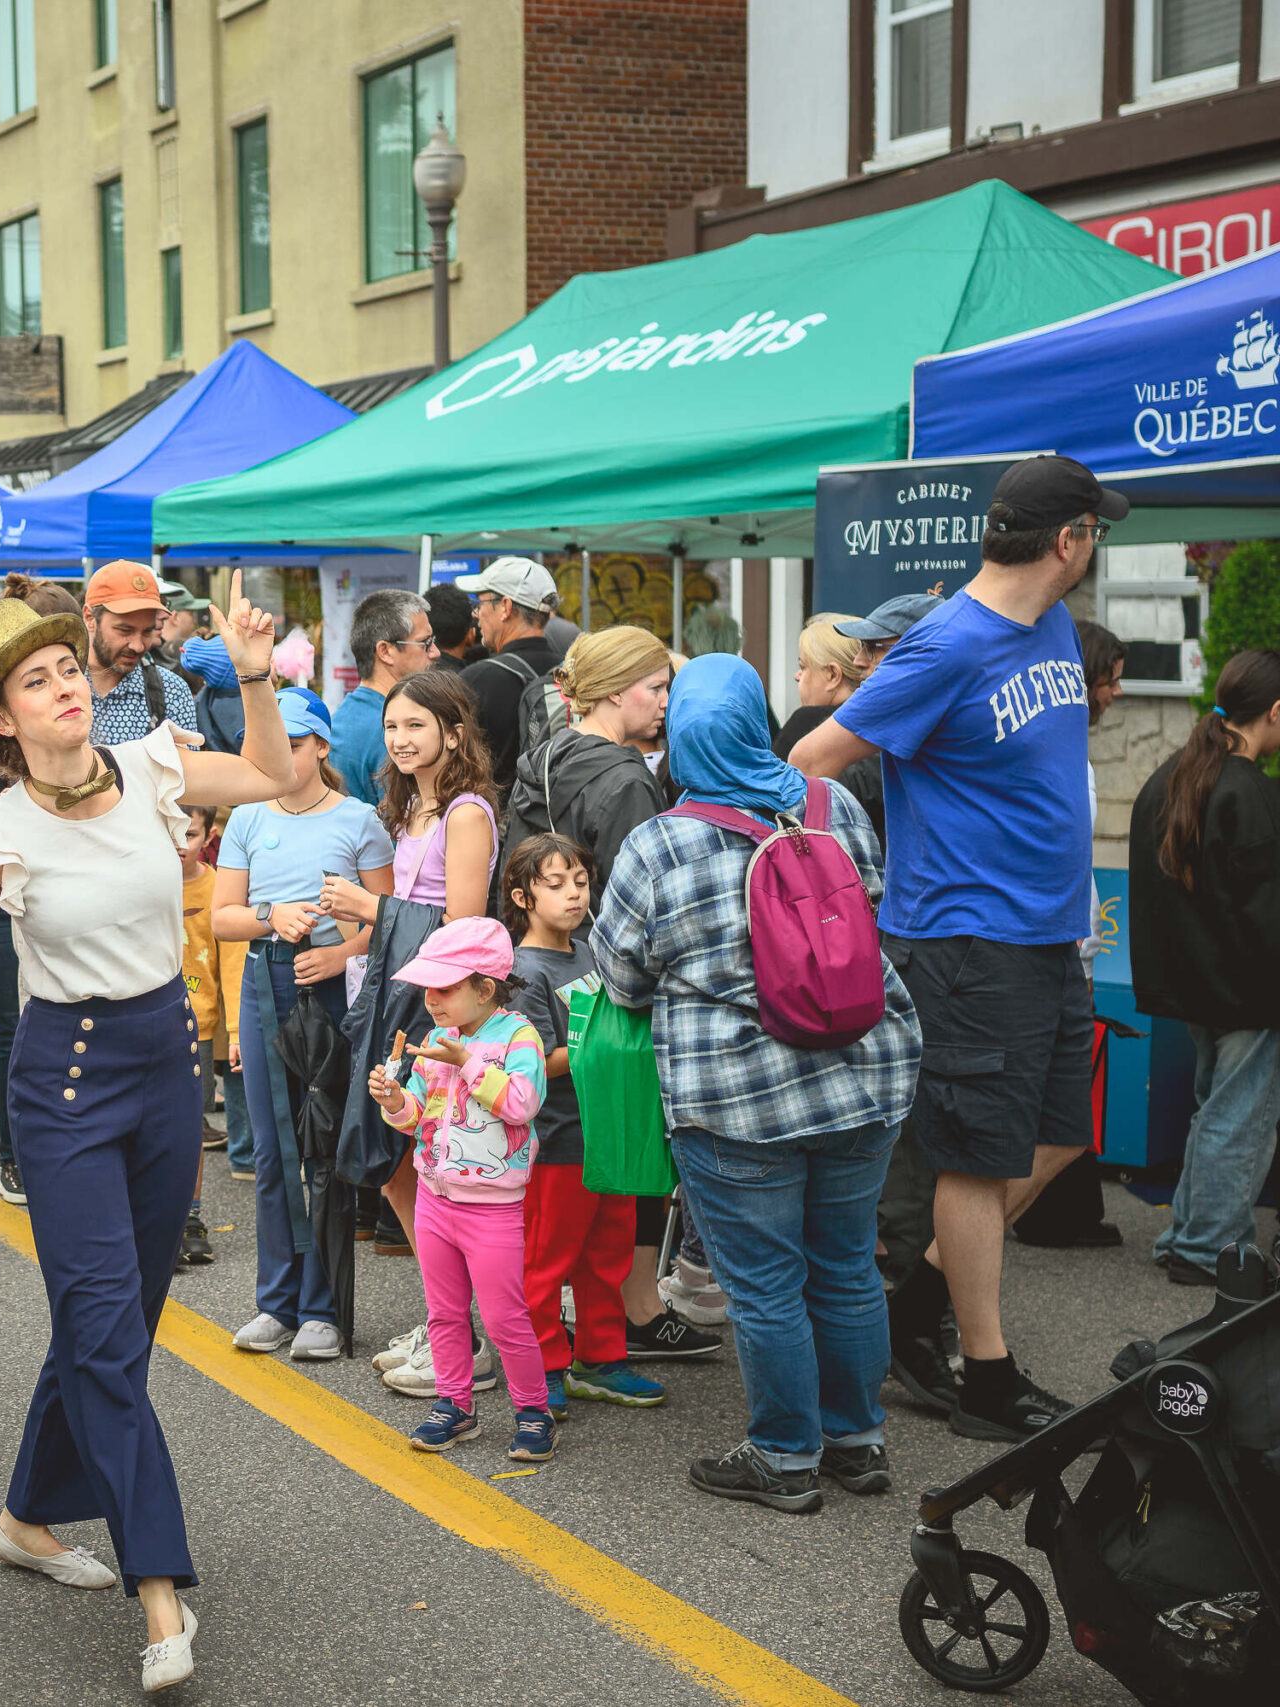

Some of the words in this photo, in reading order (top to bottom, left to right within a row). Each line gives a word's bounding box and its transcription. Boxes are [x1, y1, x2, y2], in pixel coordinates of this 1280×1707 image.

[1134, 381, 1181, 404] VILLE
[1185, 377, 1208, 398] DE
[1134, 398, 1278, 457] QUÉBEC
[897, 482, 972, 505] CABINET
[895, 560, 911, 572] JEU
[914, 558, 967, 571] D'ÉVASION
[1159, 1380, 1194, 1403] baby
[1157, 1395, 1206, 1417] jogger
